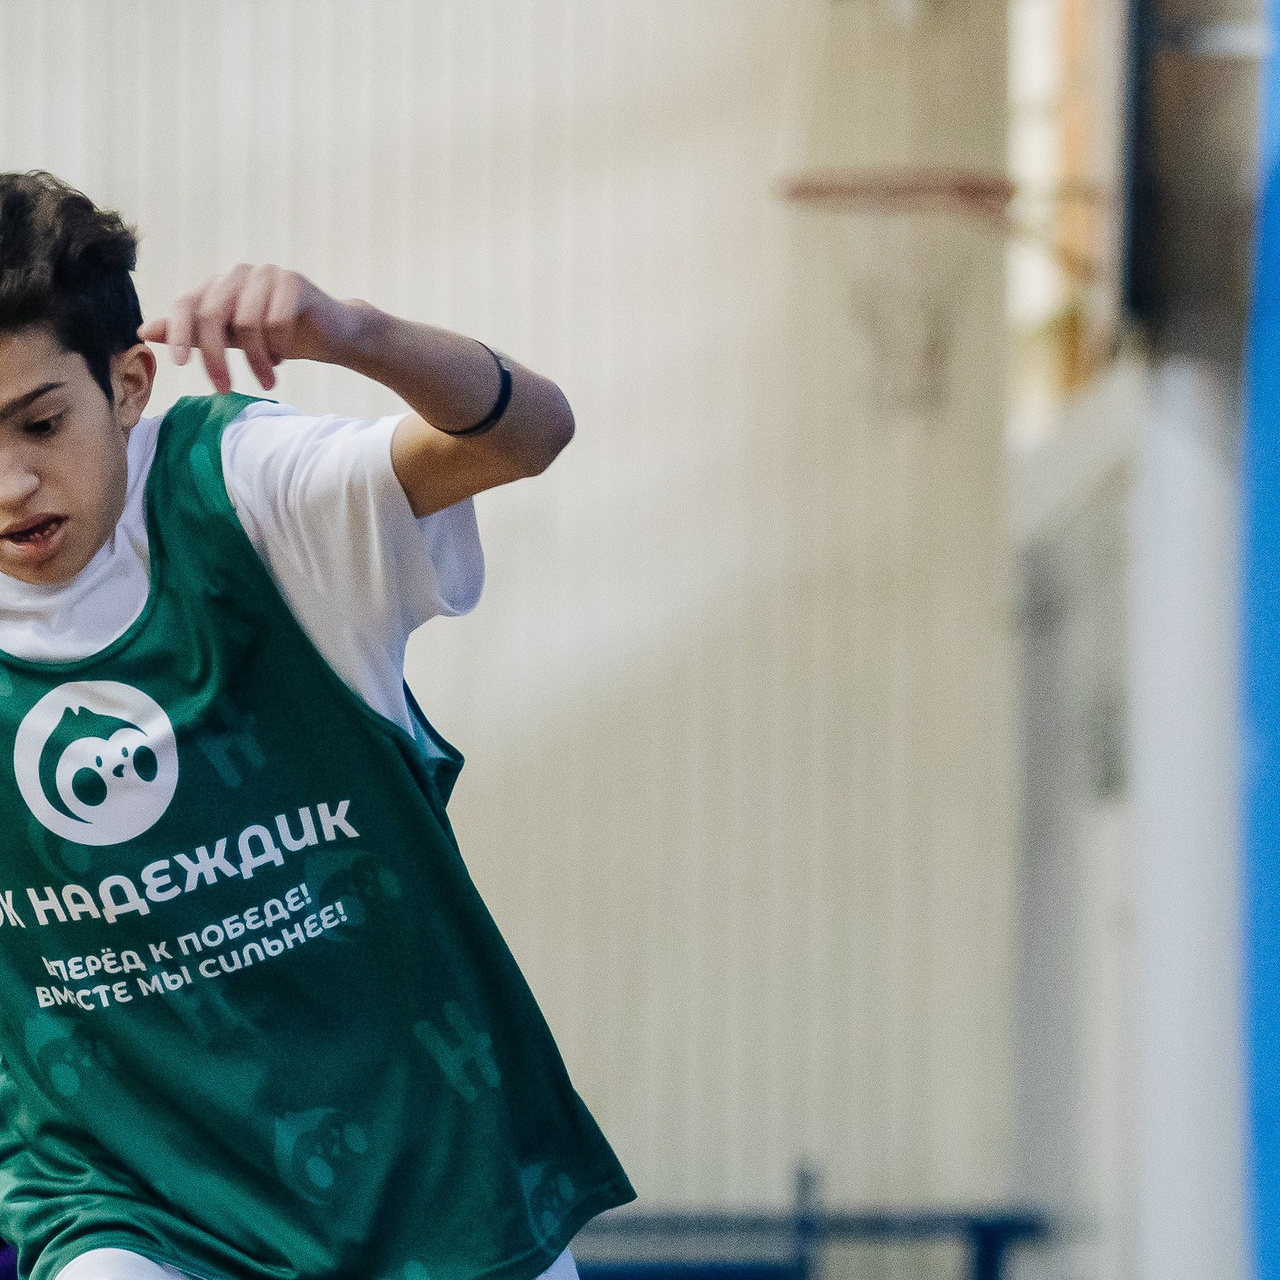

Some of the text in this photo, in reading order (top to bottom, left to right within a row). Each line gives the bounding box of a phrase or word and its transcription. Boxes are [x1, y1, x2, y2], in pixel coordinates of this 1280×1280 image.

[26, 800, 360, 926] НАДЕЖДИК
[35, 901, 348, 1011] ВМСТЕ МЫ СИЛЬНЕЕ!
[148, 941, 173, 963] К
[177, 883, 312, 956] ПОБЕДЕ!
